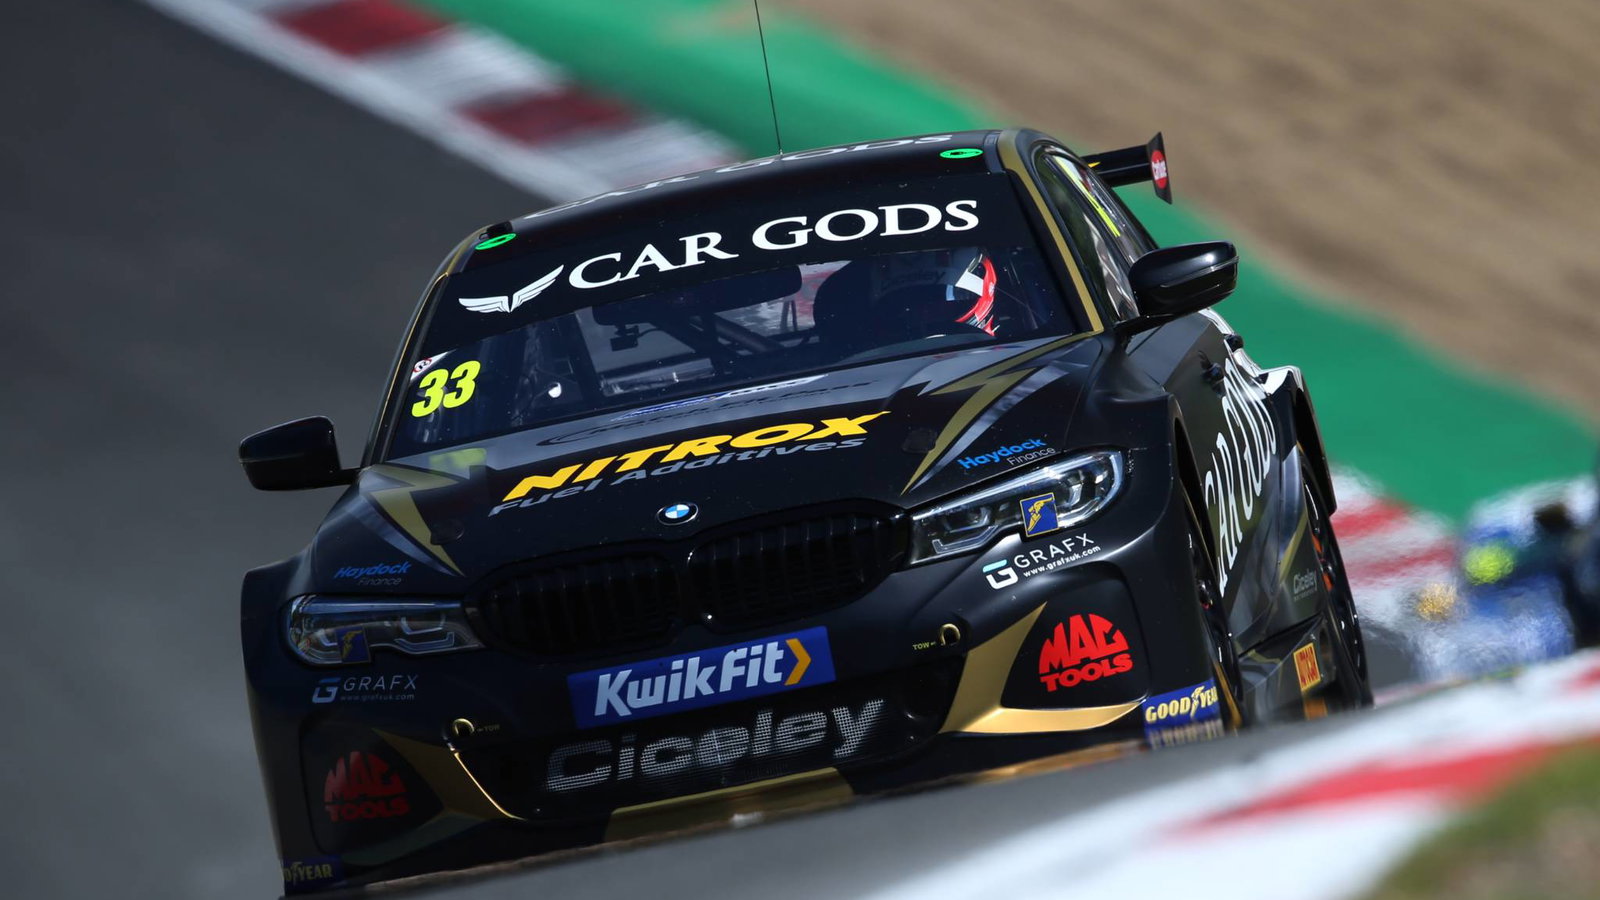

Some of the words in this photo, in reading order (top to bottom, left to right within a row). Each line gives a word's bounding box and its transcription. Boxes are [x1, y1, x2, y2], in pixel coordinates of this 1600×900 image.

[568, 231, 739, 289] CAR
[752, 200, 979, 251] GODS
[411, 360, 481, 417] 33
[502, 411, 892, 502] NITROX
[957, 438, 1047, 470] Haydock
[1006, 446, 1057, 467] Finance
[489, 479, 600, 518] Fuel
[611, 438, 866, 486] Additives
[1013, 533, 1095, 569] GRAFX
[1023, 545, 1101, 578] www.grafxuk.com
[334, 561, 412, 581] Haydock
[357, 576, 403, 587] Finance
[913, 641, 931, 650] TOW
[1038, 613, 1130, 675] MAC
[343, 675, 418, 690] GRAFX
[1040, 653, 1133, 692] TOOLS
[546, 698, 885, 793] Ciceley
[324, 751, 407, 803] MAC
[325, 797, 411, 823] TOOLS
